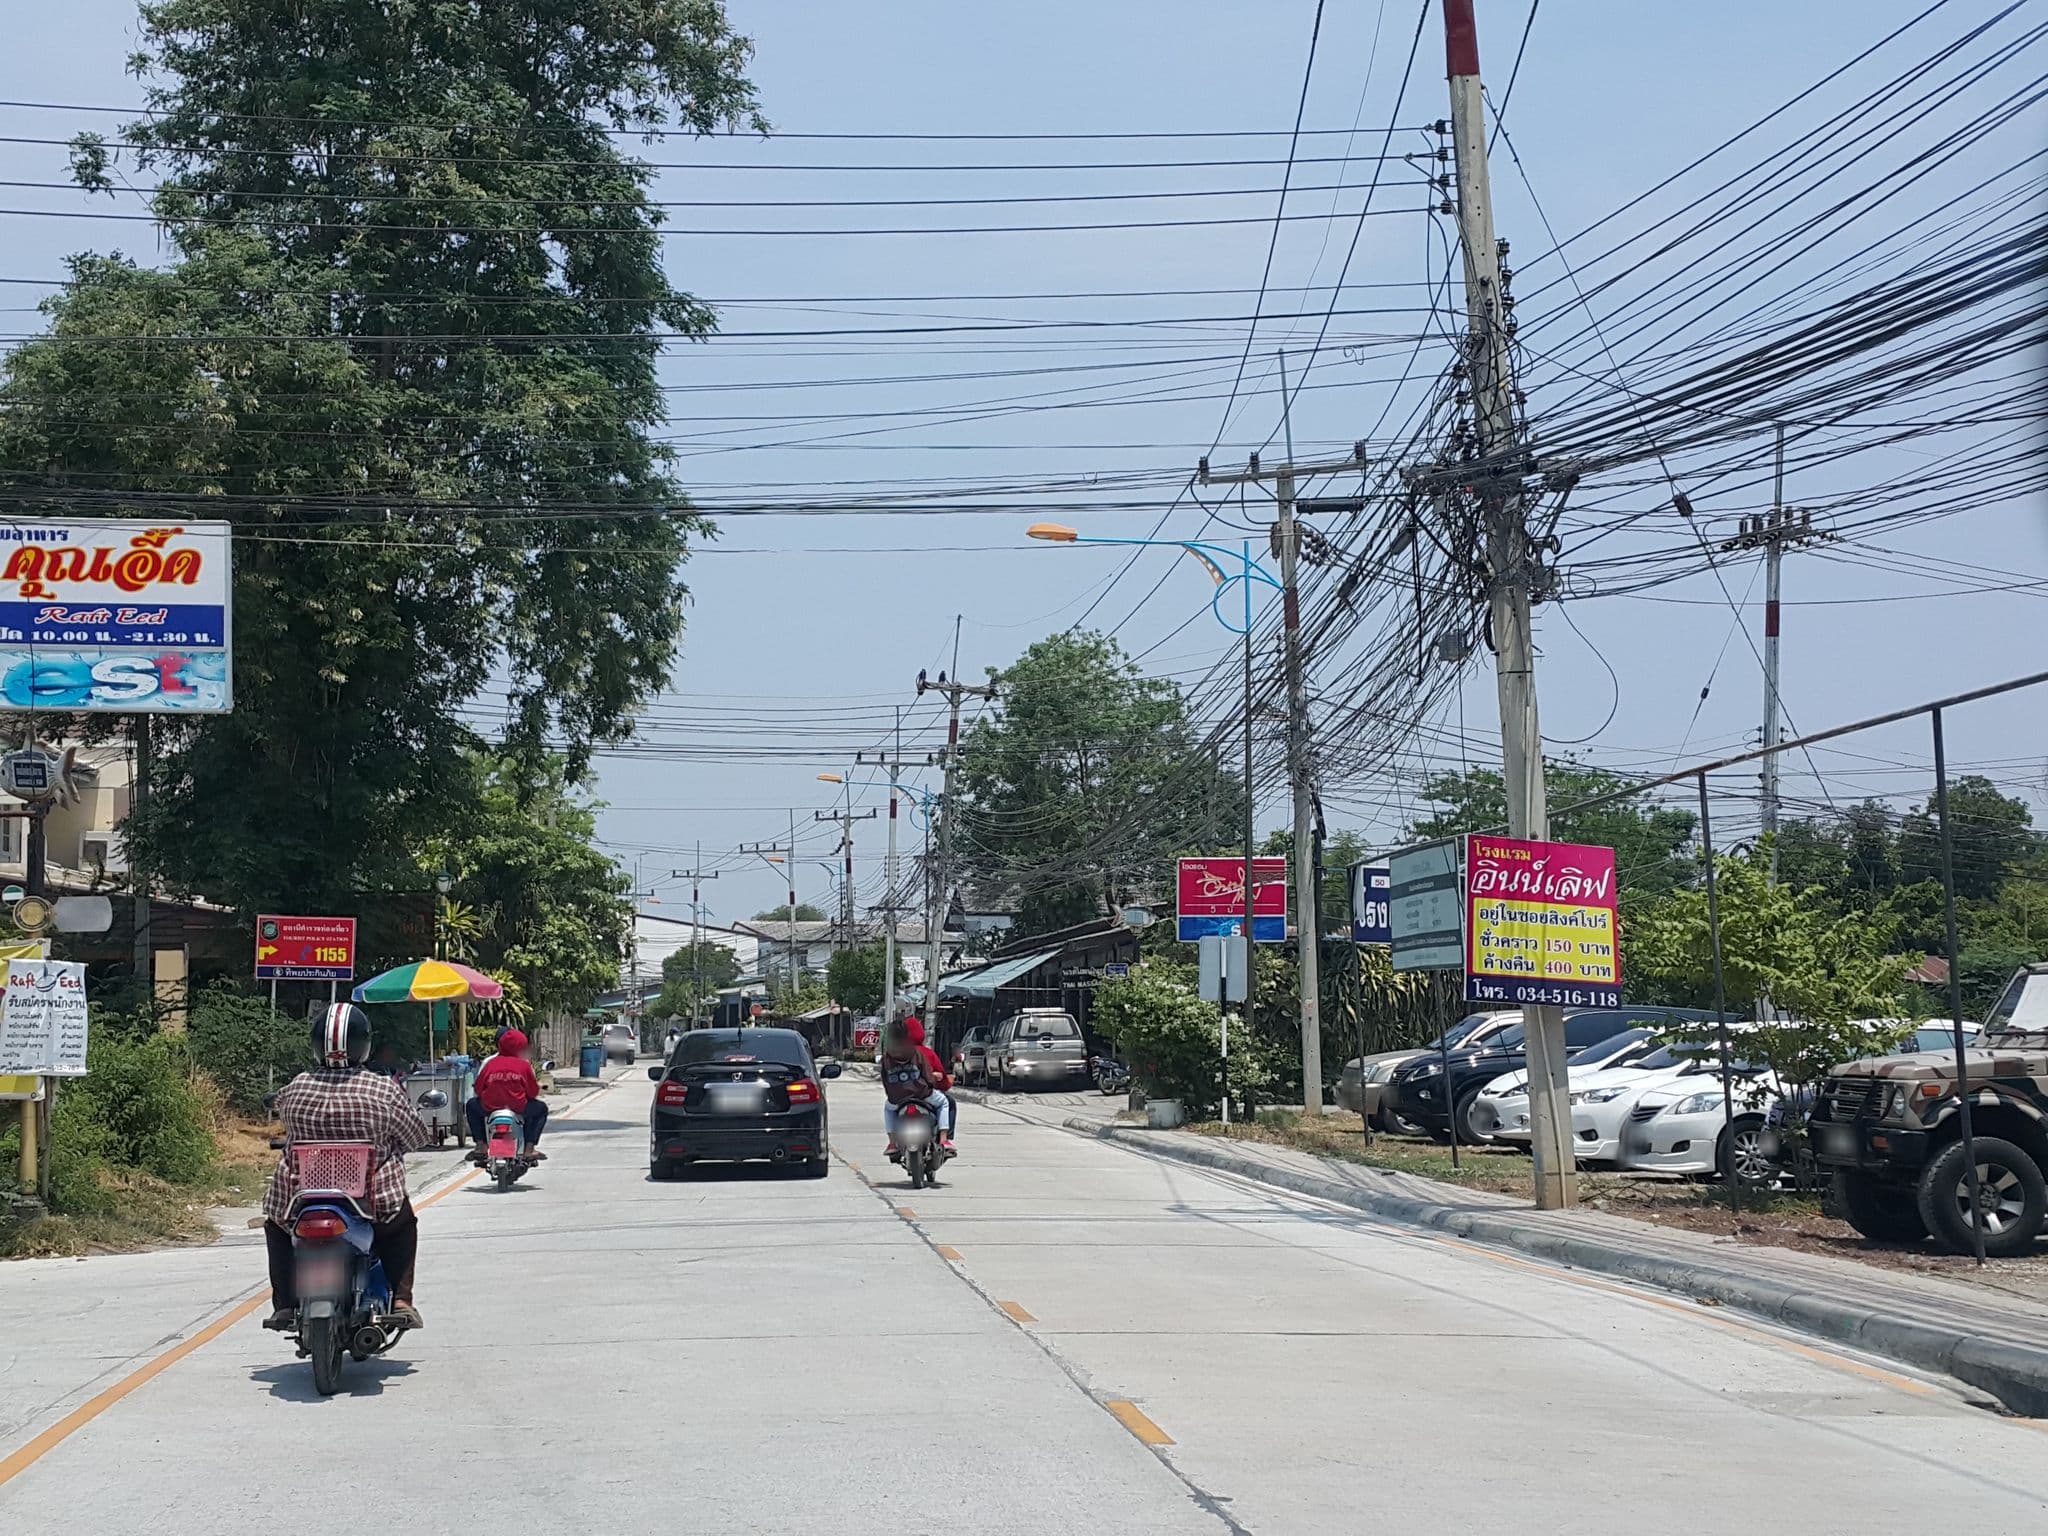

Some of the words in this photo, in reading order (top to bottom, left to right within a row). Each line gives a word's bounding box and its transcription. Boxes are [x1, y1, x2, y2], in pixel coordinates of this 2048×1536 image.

[31, 630, 88, 641] 10.00
[3, 652, 197, 705] est
[1474, 839, 1531, 861] โรงแรม
[1471, 855, 1612, 900] อินน์เลิฟ
[1480, 928, 1538, 950] ชั่วคราว
[1545, 938, 1572, 953] 150
[1578, 942, 1611, 956] บาท
[314, 947, 347, 962] 1155
[1483, 953, 1536, 972] ค้างคืน
[1544, 962, 1573, 974] 400
[1579, 964, 1612, 978] บาท
[11, 972, 35, 989] Raft
[60, 975, 82, 988] Eed
[8, 995, 85, 1009] รับสมัครพนักงาน
[1473, 979, 1508, 999] โทร.
[1516, 986, 1618, 1007] 034-516-118
